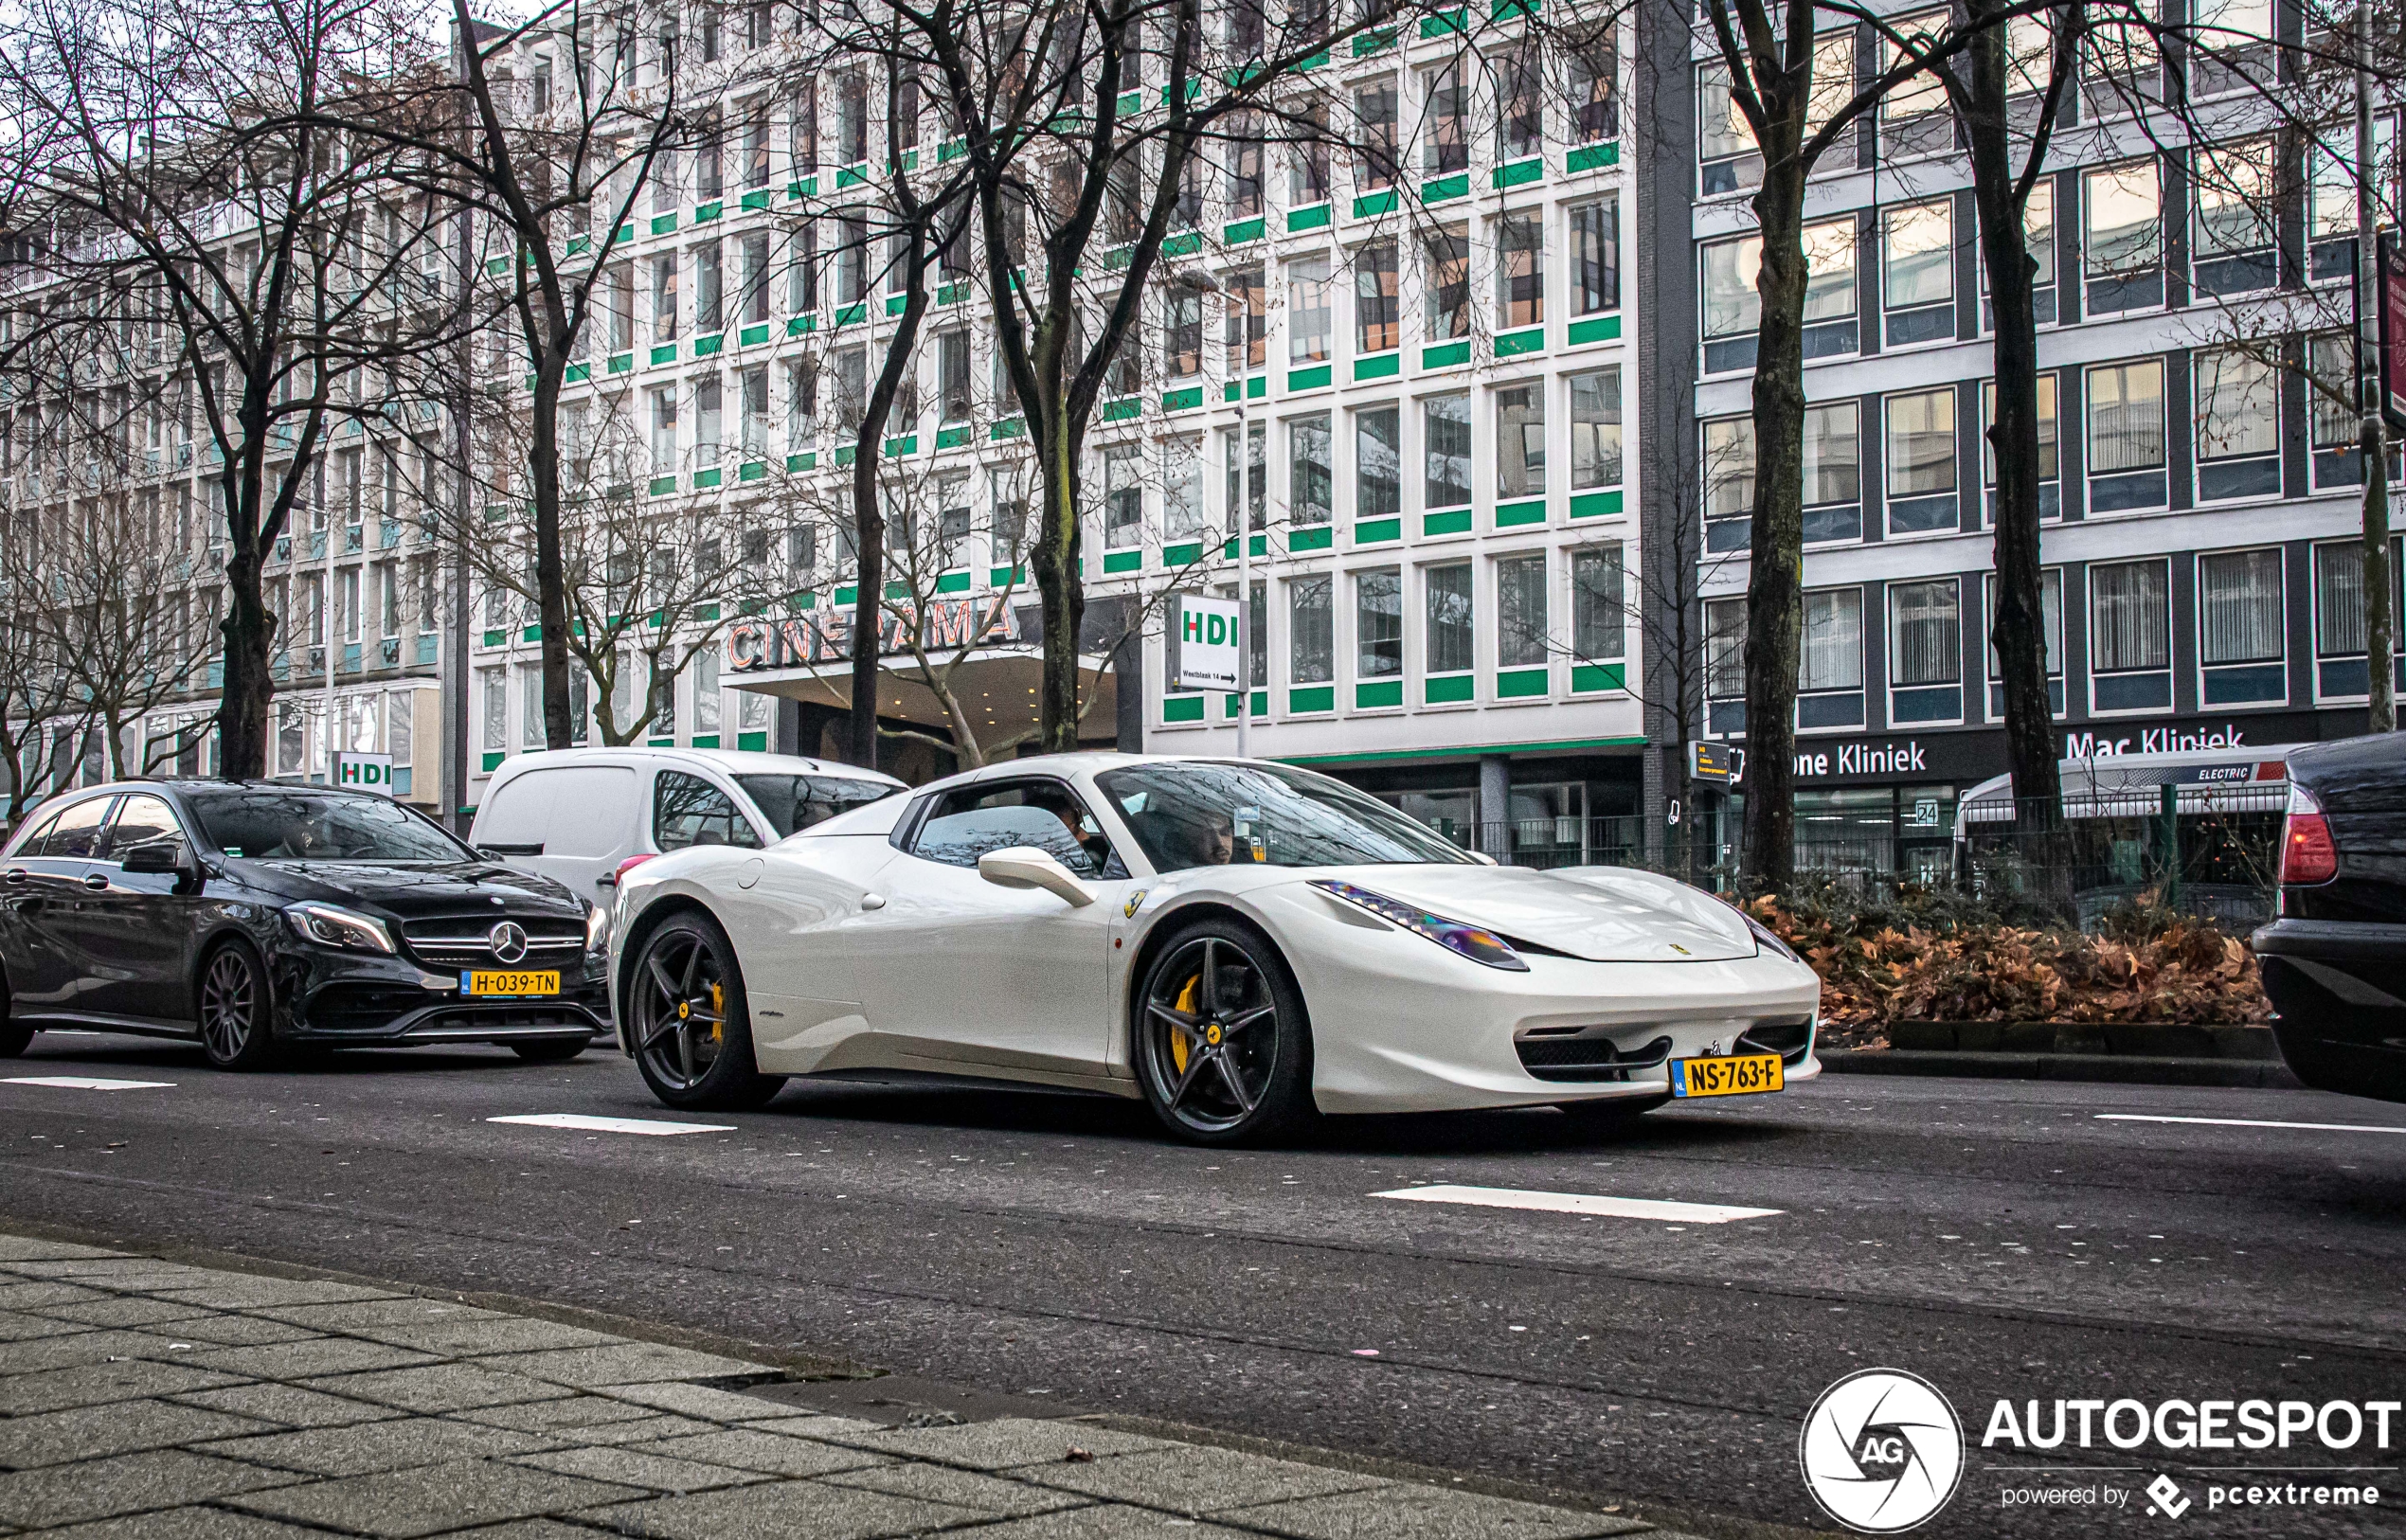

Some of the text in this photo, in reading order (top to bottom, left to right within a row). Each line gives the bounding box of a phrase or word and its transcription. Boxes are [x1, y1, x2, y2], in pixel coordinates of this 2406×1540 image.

[1183, 611, 1238, 647] HDI
[1183, 670, 1212, 679] Westblaak
[2066, 724, 2243, 759] Mac Kliniek
[1838, 741, 1927, 775] Kliniek
[341, 762, 390, 784] HDI
[2199, 767, 2248, 780] ELECTRIC
[1918, 806, 1937, 821] 24
[476, 975, 555, 992] H-039-TN
[1691, 1060, 1774, 1091] NS-763-F
[1675, 1082, 1684, 1091] NL
